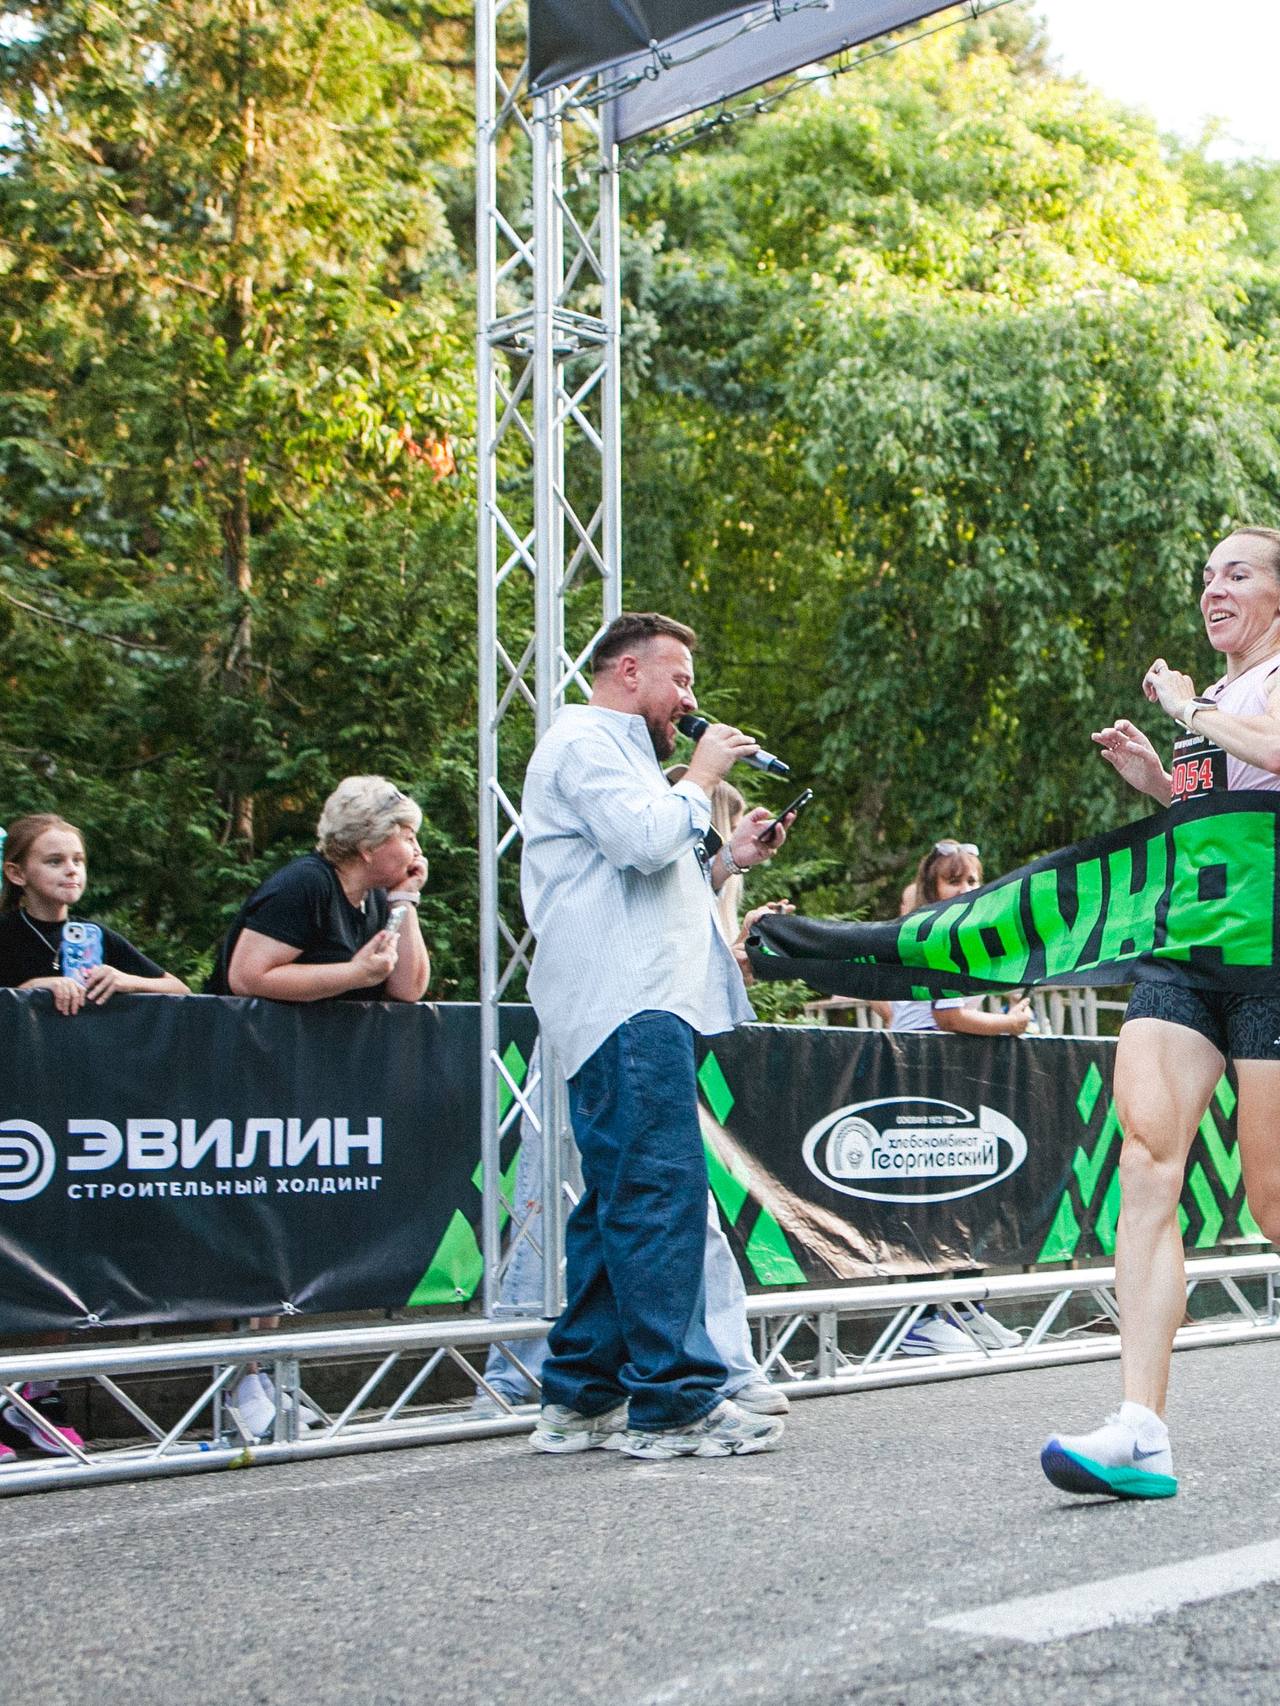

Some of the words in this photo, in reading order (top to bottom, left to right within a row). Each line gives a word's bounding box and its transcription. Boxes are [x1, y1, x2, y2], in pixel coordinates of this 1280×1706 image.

[1172, 757, 1213, 796] 054
[67, 1117, 382, 1170] ЭВИЛИН
[67, 1177, 267, 1199] СТРОИТЕЛЬНЫЙ
[276, 1176, 382, 1194] ХОЛДИНГ
